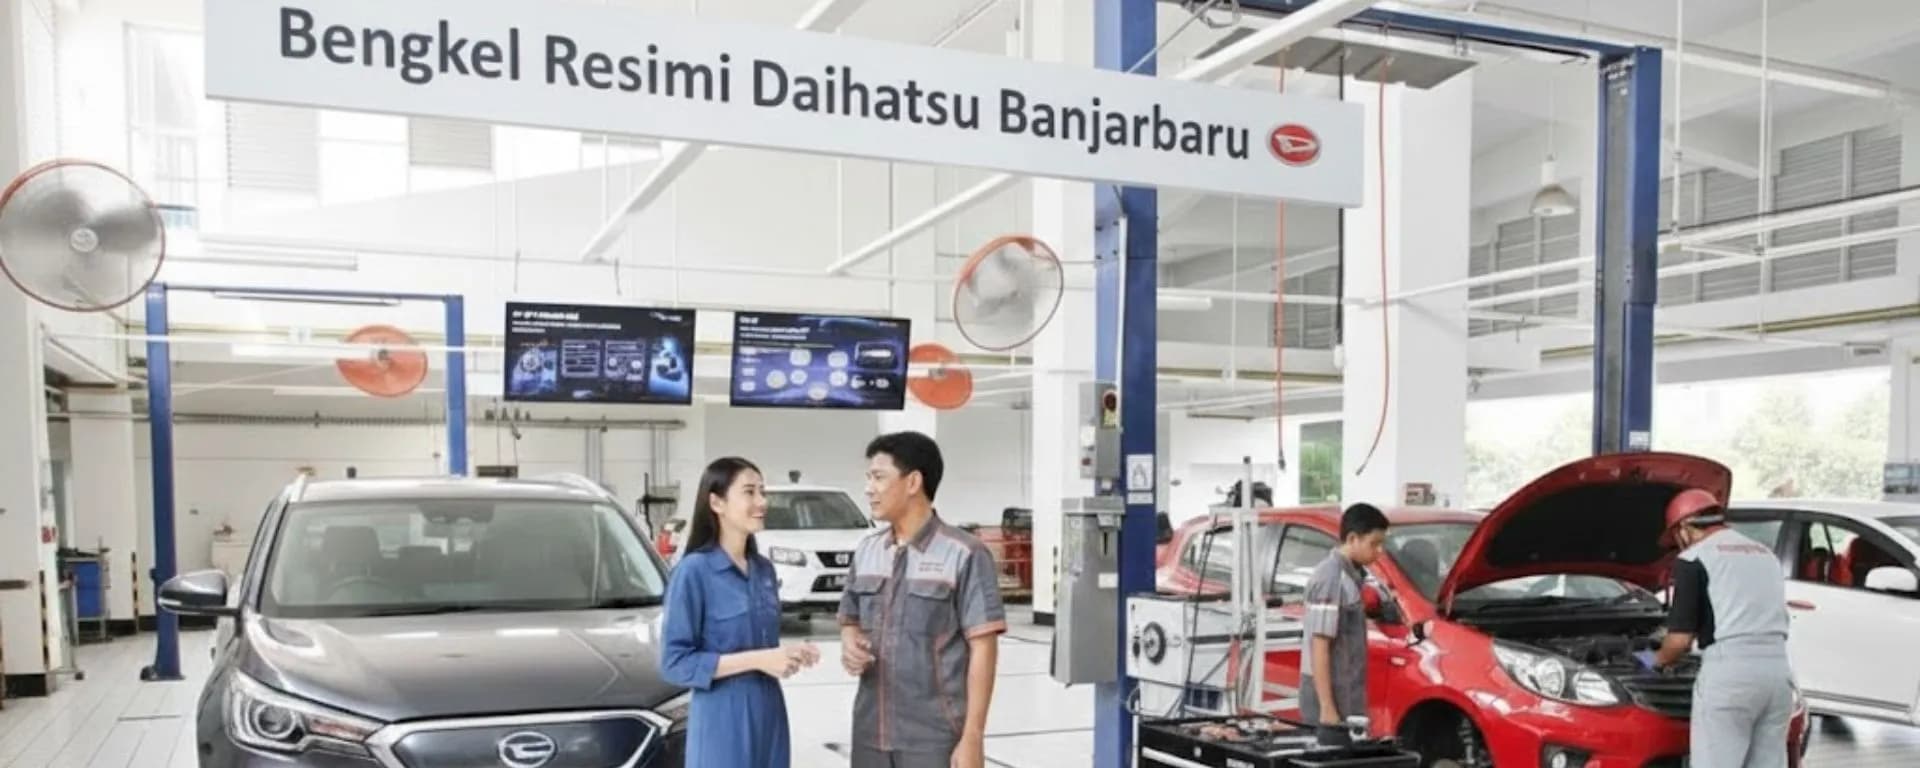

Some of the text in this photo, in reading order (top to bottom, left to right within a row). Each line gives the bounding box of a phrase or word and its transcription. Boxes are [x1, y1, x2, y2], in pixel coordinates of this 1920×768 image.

[280, 7, 1250, 160] Bengkel Resimi Daihatsu Banjarbaru
